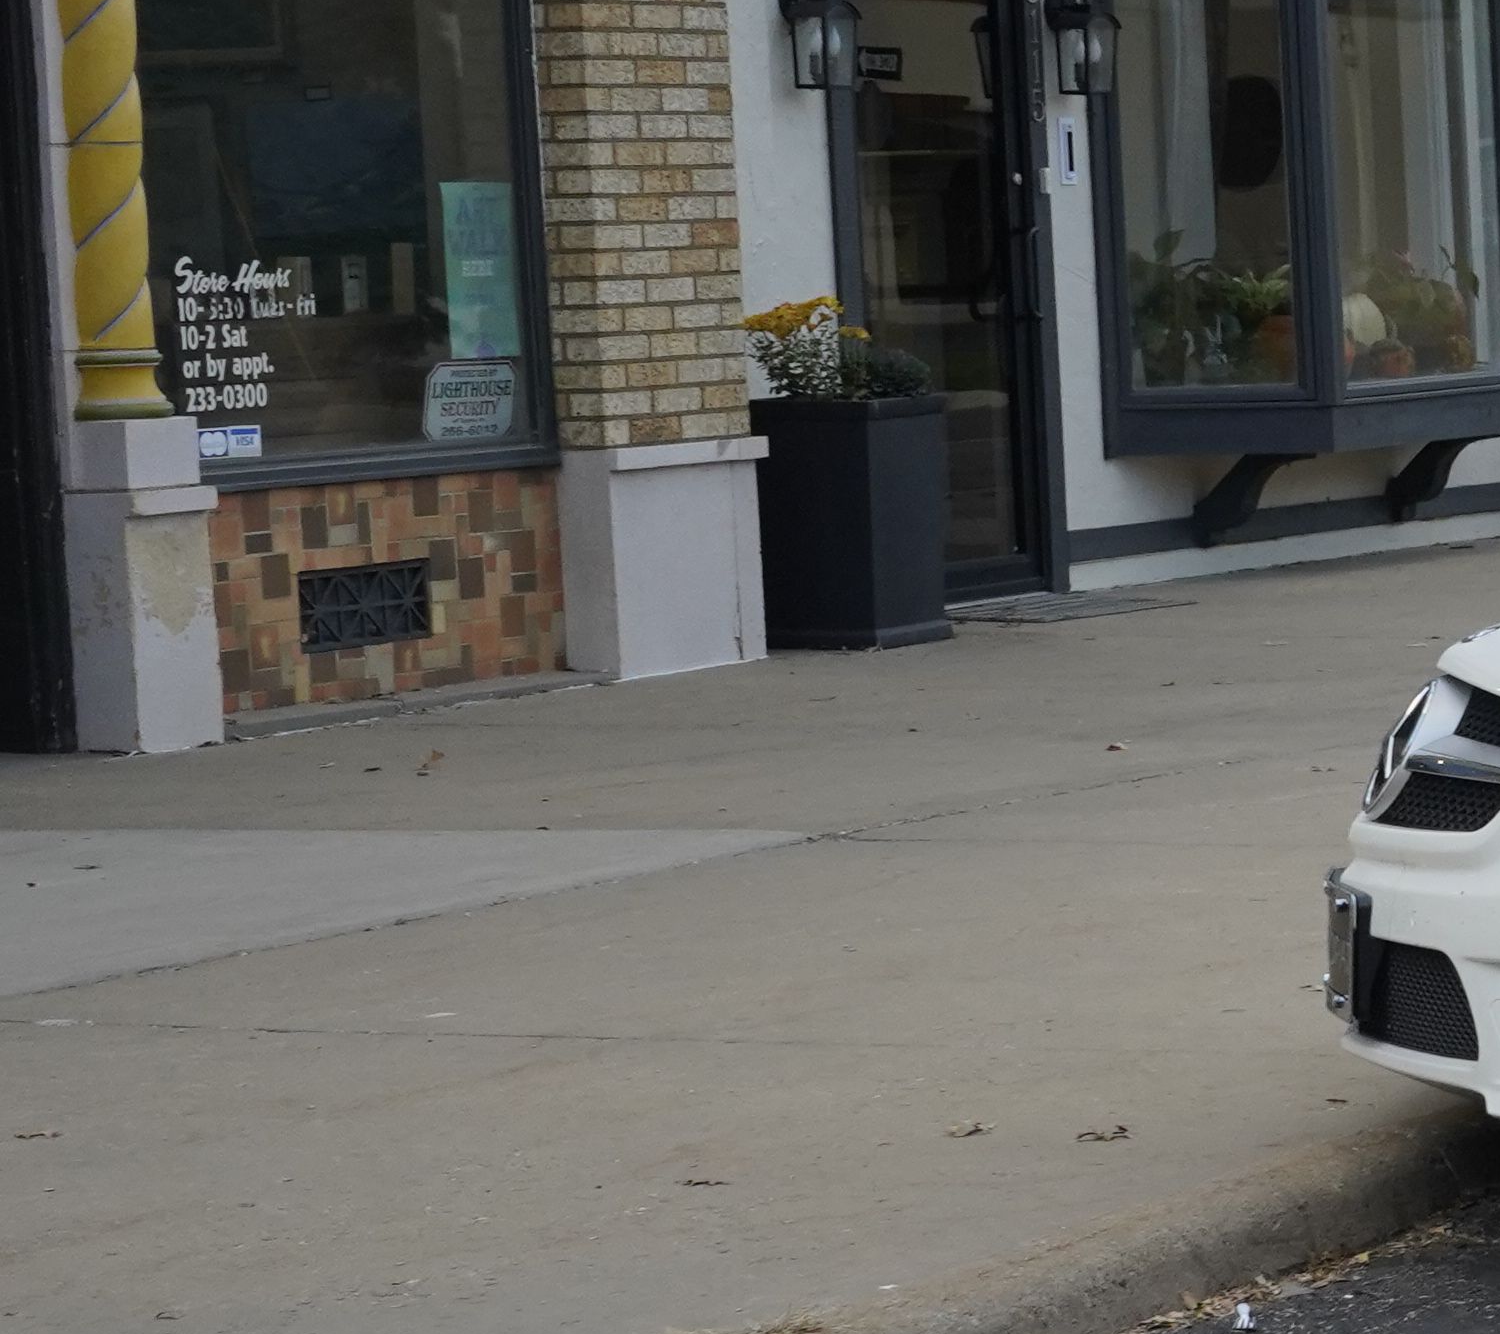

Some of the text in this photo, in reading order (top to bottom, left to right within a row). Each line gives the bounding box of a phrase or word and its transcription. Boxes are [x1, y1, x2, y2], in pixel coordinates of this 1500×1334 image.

[174, 255, 293, 295] Store Hours
[180, 323, 249, 351] 10-2 Sat
[183, 352, 275, 382] or by appt.
[185, 382, 268, 413] 233-0300
[432, 379, 513, 399] LIGHTHOUSE
[440, 397, 500, 417] SECURITY
[235, 435, 254, 446] VISA
